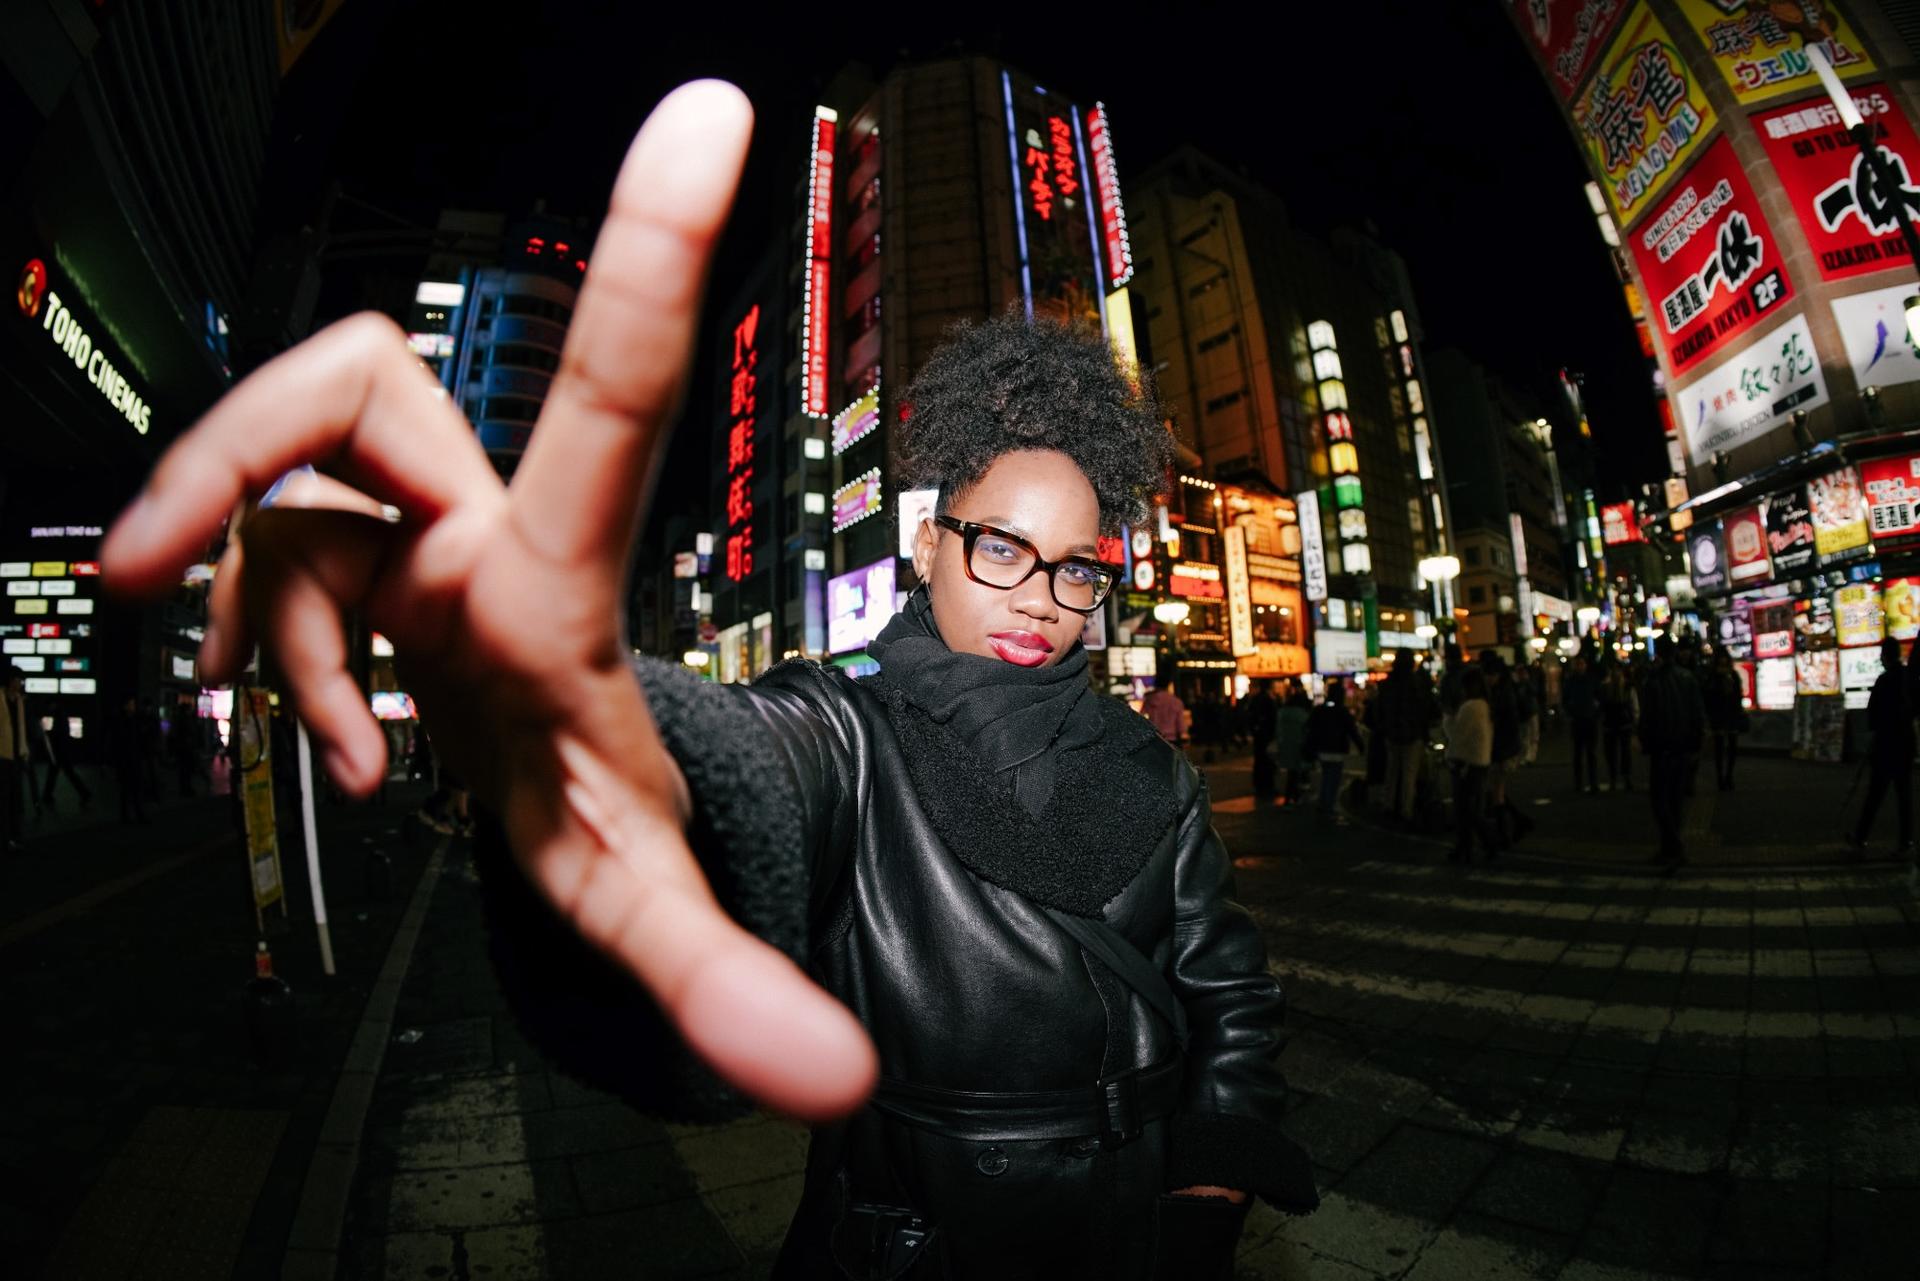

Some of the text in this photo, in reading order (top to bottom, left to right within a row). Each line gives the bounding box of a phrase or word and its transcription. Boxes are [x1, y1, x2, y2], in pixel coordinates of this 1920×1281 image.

[1706, 12, 1789, 56] 麻雀
[1601, 43, 1684, 171] 麻雀
[1617, 102, 1700, 209] WELCOME
[1754, 274, 1778, 308] 2F
[43, 291, 151, 434] TOHO CINEMAS
